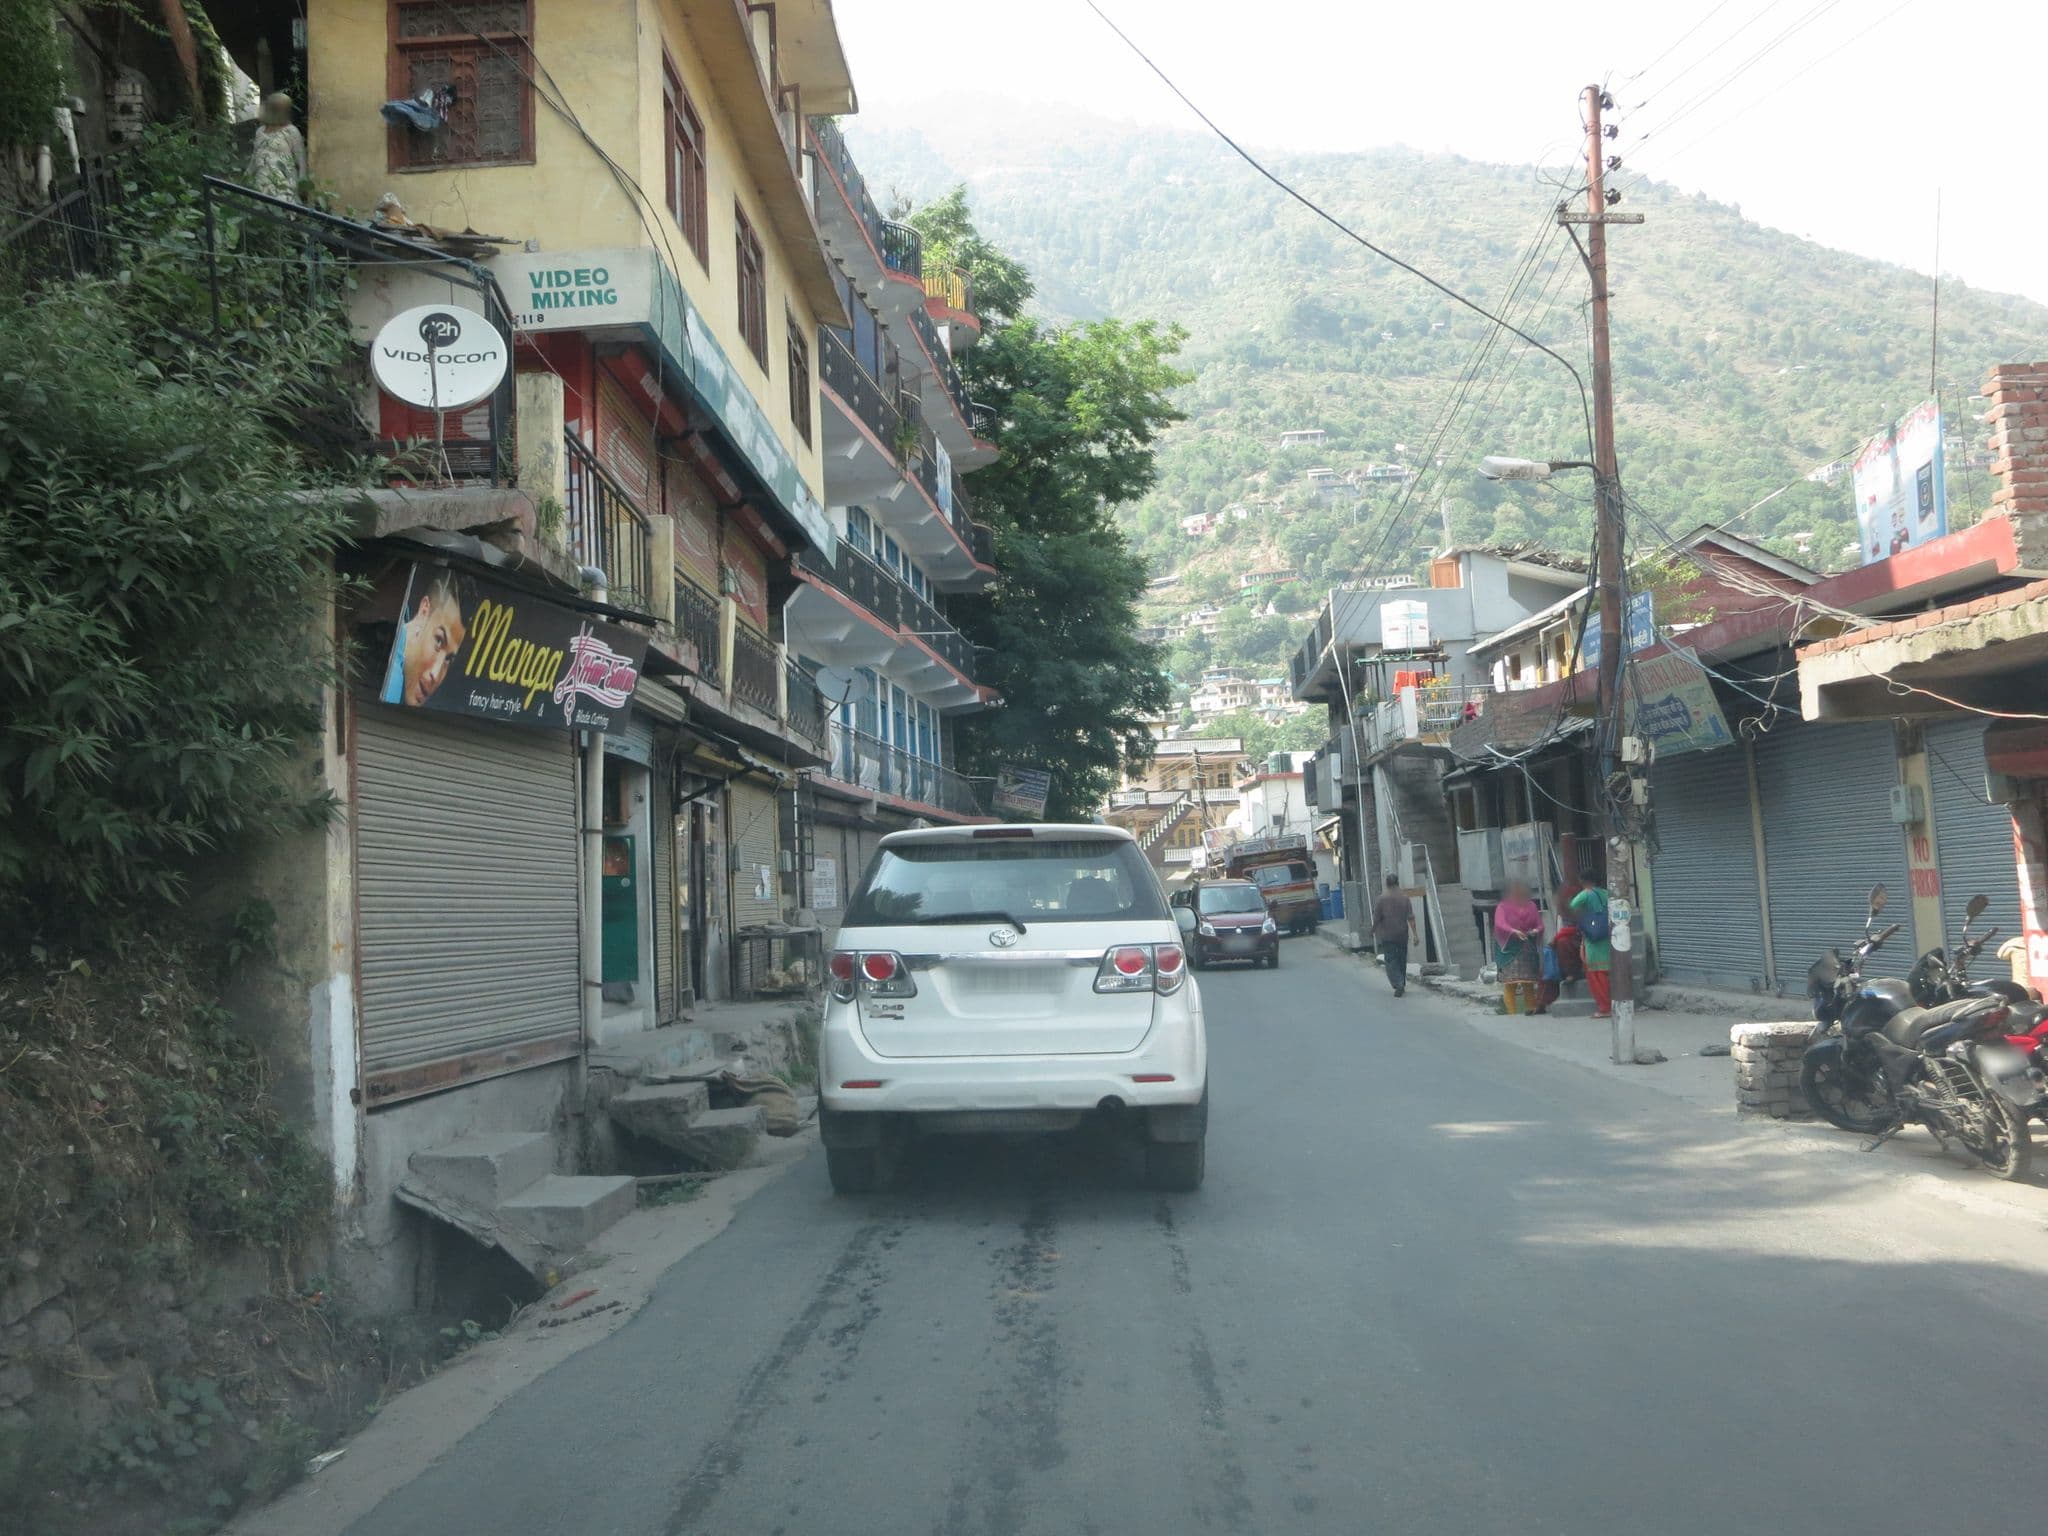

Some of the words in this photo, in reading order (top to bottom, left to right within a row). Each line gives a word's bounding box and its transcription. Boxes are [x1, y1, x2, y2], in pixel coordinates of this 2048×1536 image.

[528, 268, 609, 288] VIDEO
[531, 288, 618, 310] MIXING
[504, 697, 521, 716] style
[1913, 837, 1930, 863] NO
